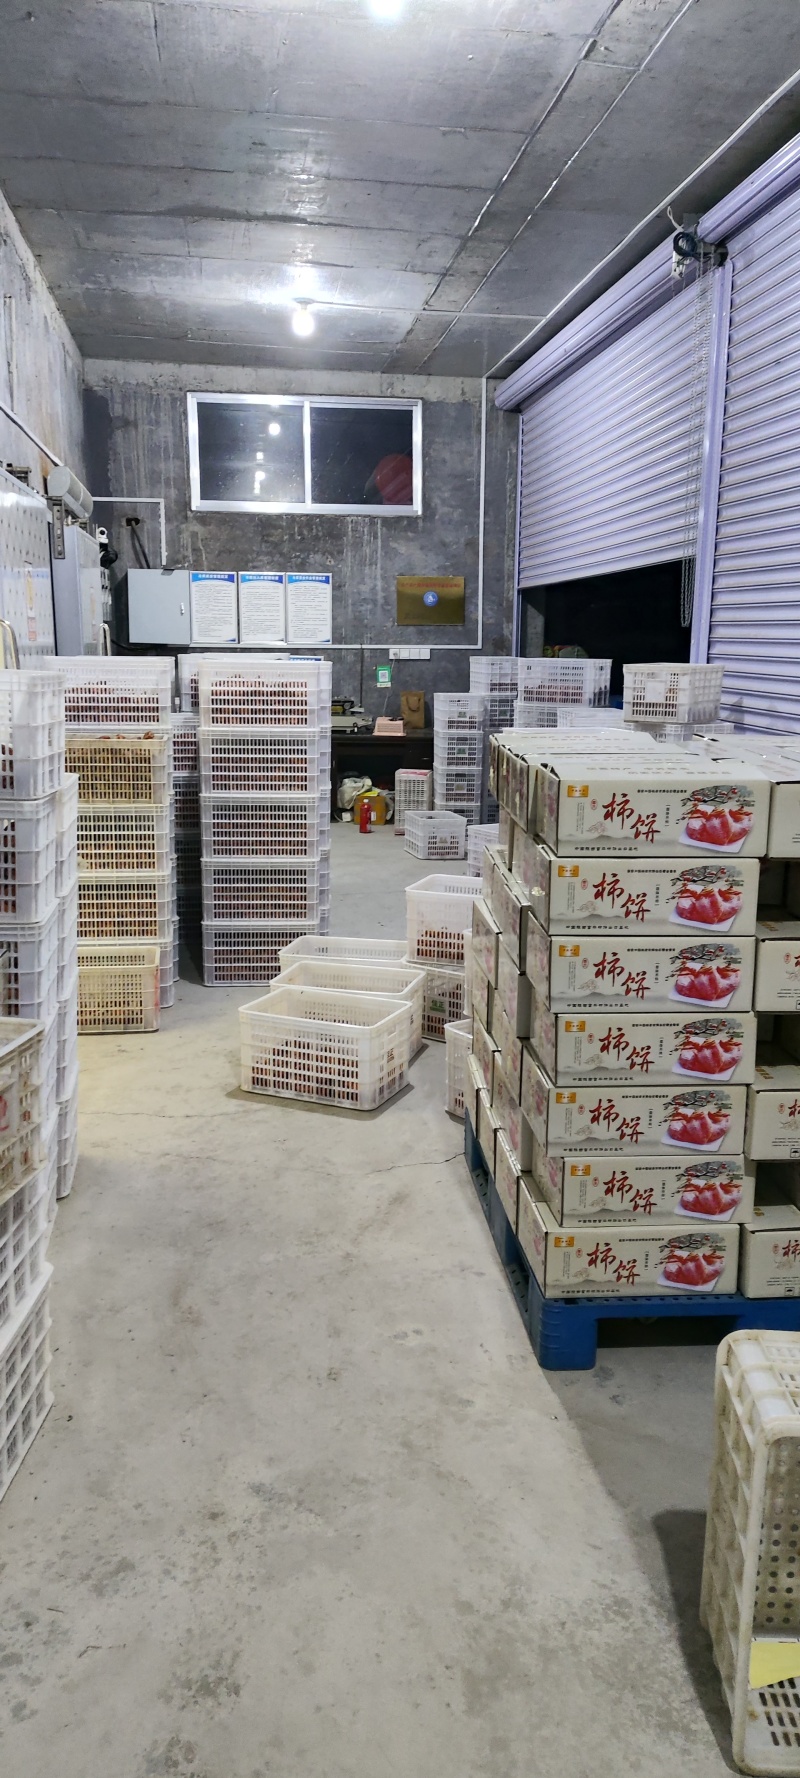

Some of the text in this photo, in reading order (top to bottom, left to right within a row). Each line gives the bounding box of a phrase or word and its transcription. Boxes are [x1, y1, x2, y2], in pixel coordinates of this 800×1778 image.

[602, 792, 660, 843] 柿饼
[593, 872, 651, 923] 柿饼
[593, 951, 651, 1000] 柿饼
[599, 1026, 655, 1073] 柿饼
[590, 1098, 644, 1144] 柿饼
[603, 1170, 657, 1215] 柿饼
[587, 1242, 640, 1286] 柿饼
